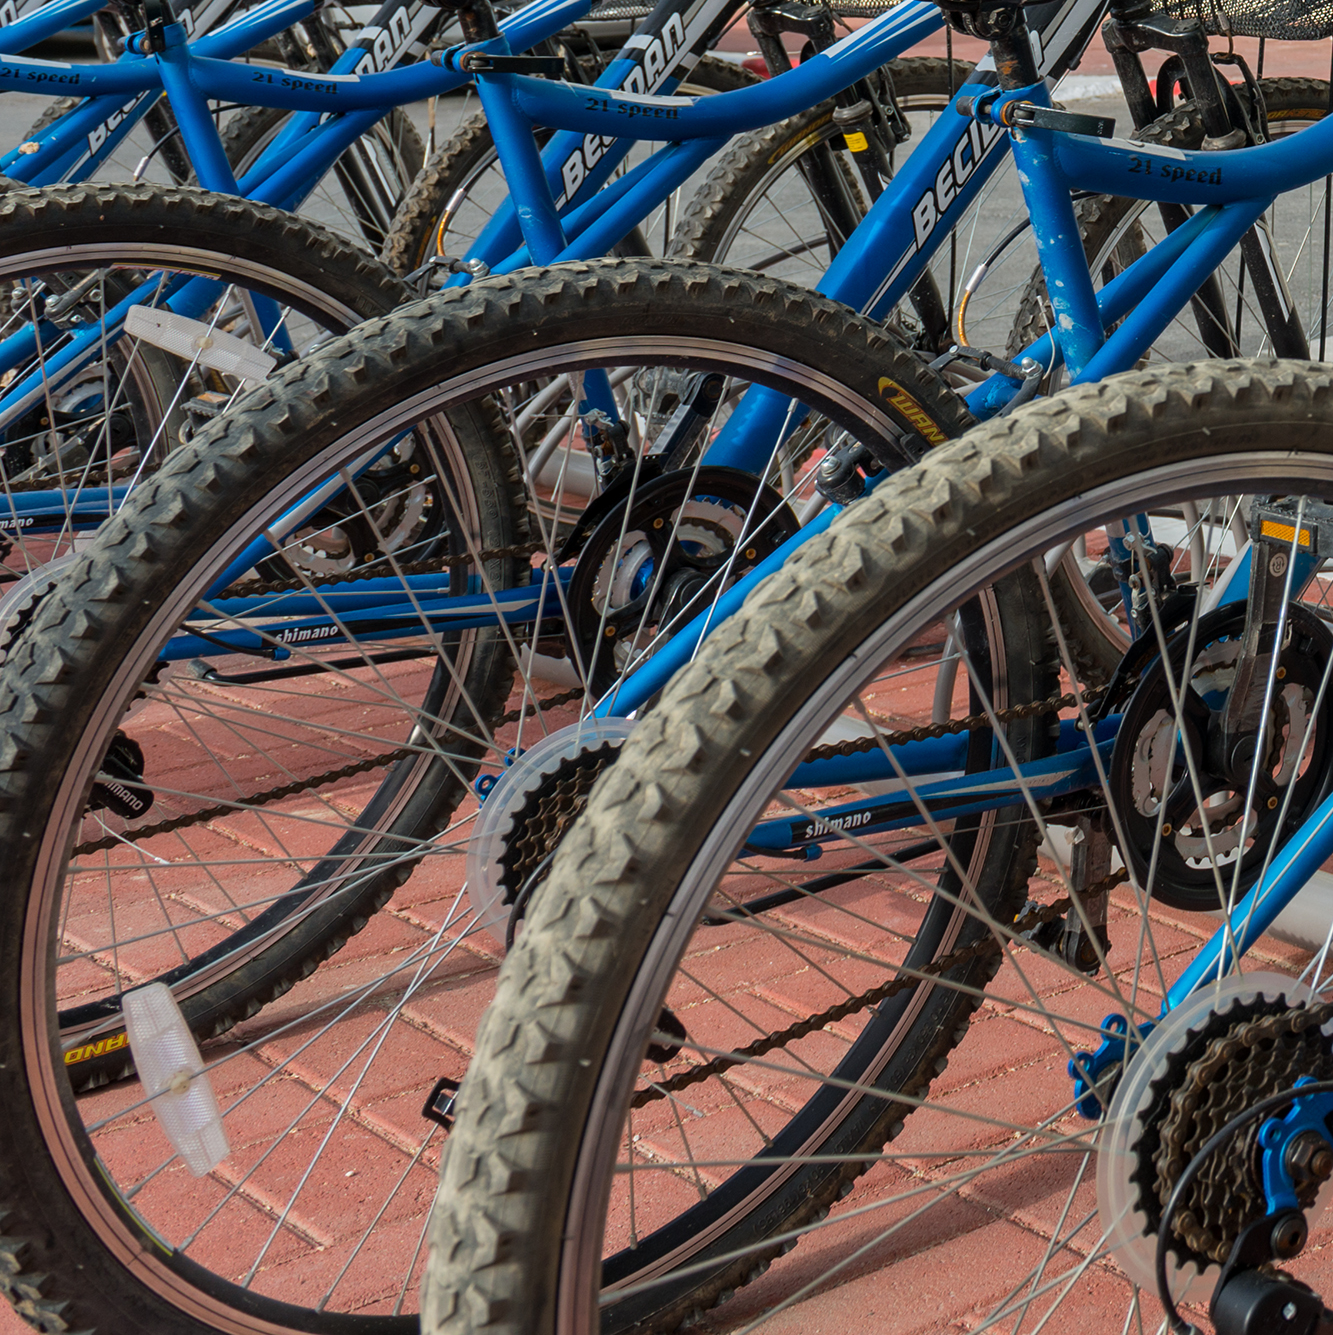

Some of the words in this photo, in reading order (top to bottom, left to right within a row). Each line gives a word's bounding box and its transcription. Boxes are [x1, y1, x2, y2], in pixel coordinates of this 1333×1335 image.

[0, 67, 20, 78] 21
[27, 71, 80, 84] speed
[251, 71, 273, 84] 21
[281, 77, 338, 94] speed
[585, 97, 609, 112] 21
[617, 102, 680, 119] speed
[1128, 156, 1152, 175] 21
[1160, 164, 1223, 185] speed
[0, 517, 34, 529] mano
[276, 625, 338, 643] shimano
[103, 781, 144, 811] IMANO
[805, 811, 872, 838] shimano
